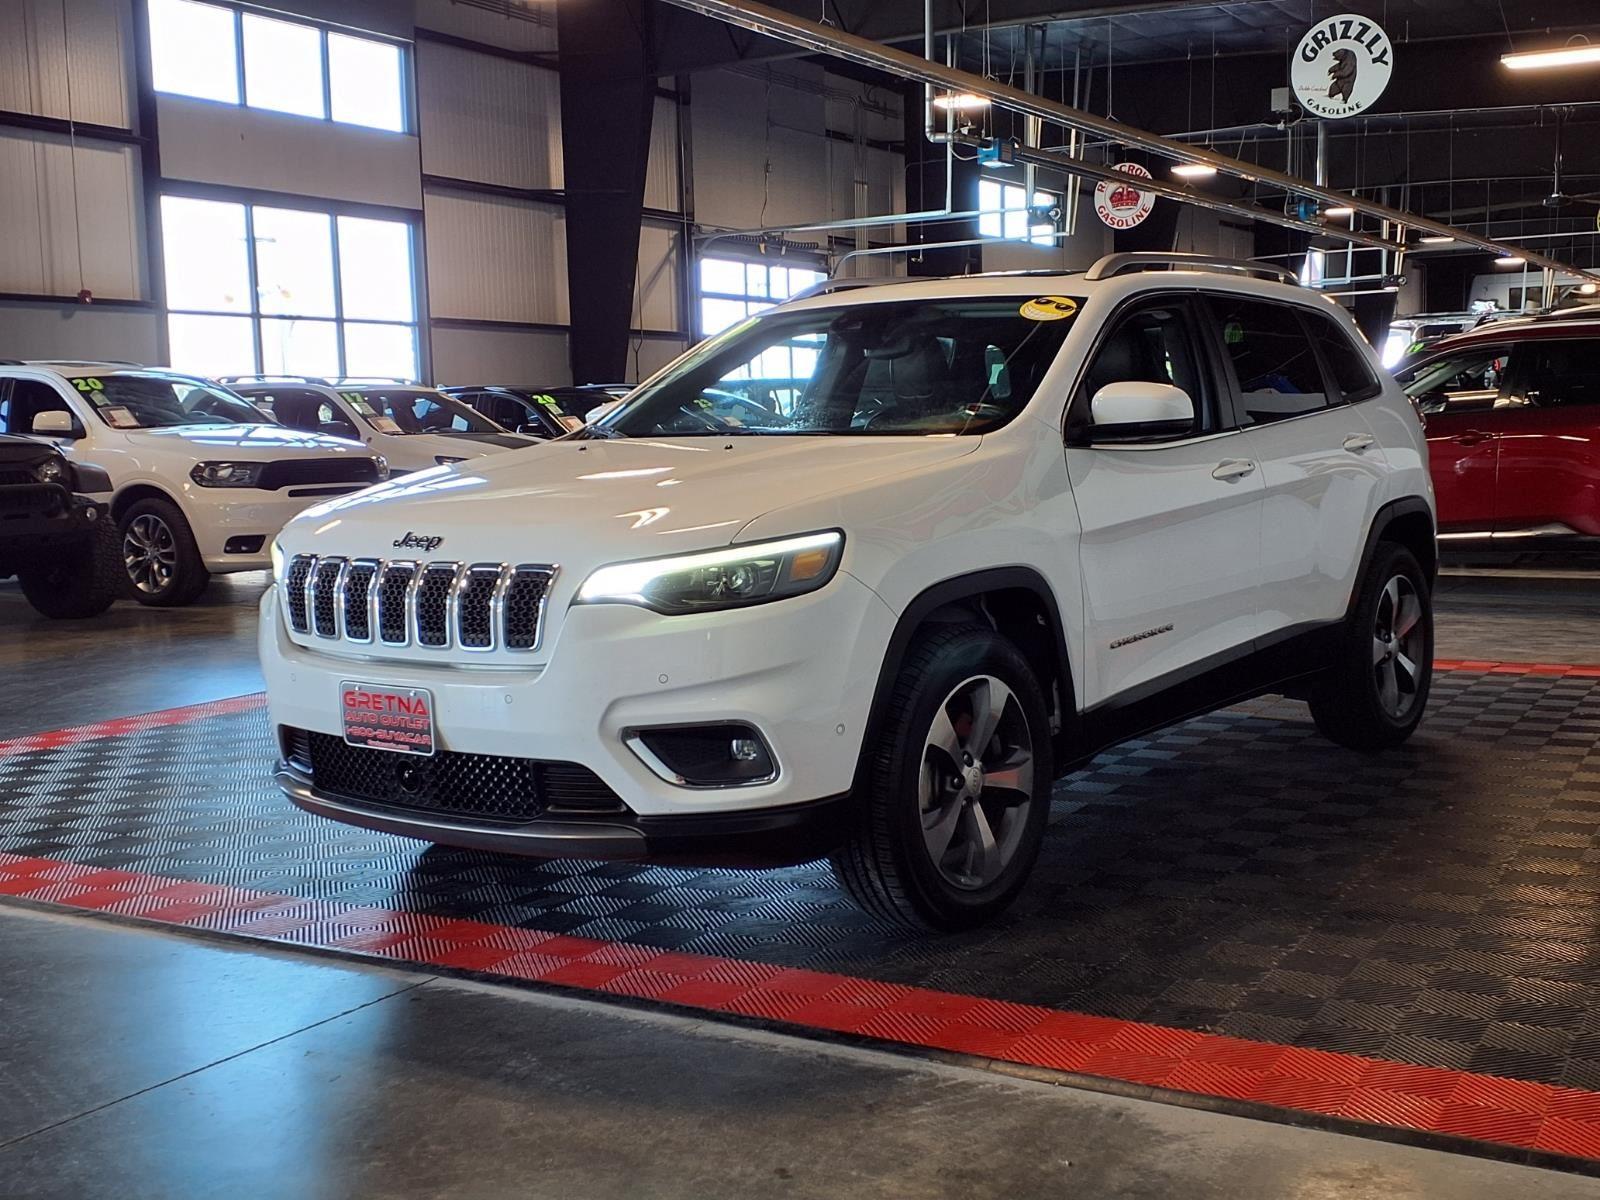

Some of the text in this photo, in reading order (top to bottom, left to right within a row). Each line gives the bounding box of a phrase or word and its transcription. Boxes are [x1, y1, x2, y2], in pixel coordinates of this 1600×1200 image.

[1301, 20, 1389, 66] GRIZZLY
[1307, 98, 1363, 115] GASOLINE
[1098, 203, 1151, 228] GASOLINE
[72, 378, 104, 391] 20
[532, 394, 556, 404] 20
[392, 531, 445, 551] Jeep
[343, 691, 429, 716] GRETNA
[344, 710, 431, 730] AUTO OUTLET
